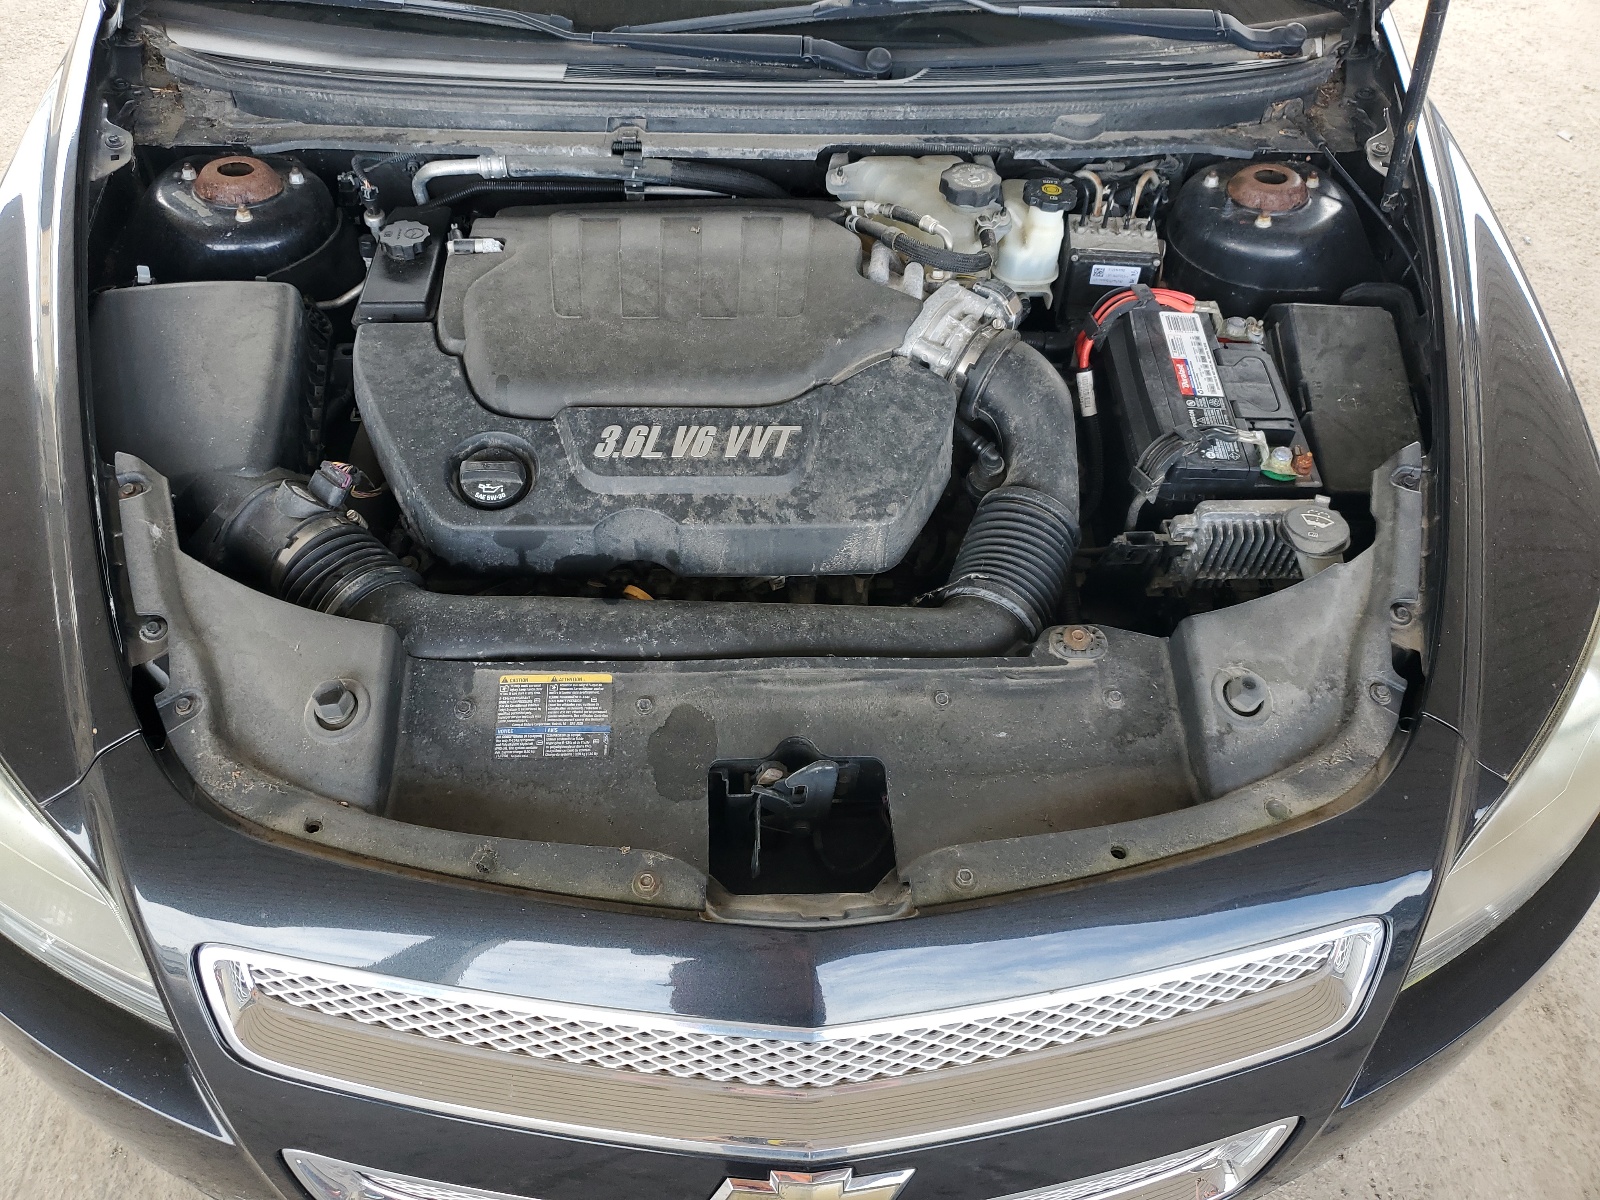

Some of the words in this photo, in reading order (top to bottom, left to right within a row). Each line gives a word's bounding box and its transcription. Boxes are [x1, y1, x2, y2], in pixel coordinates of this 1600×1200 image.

[593, 425, 663, 458] 3.6L
[671, 425, 717, 458] V6
[724, 425, 802, 458] VVT
[475, 492, 486, 500] SAE
[487, 492, 506, 500] 5W-30
